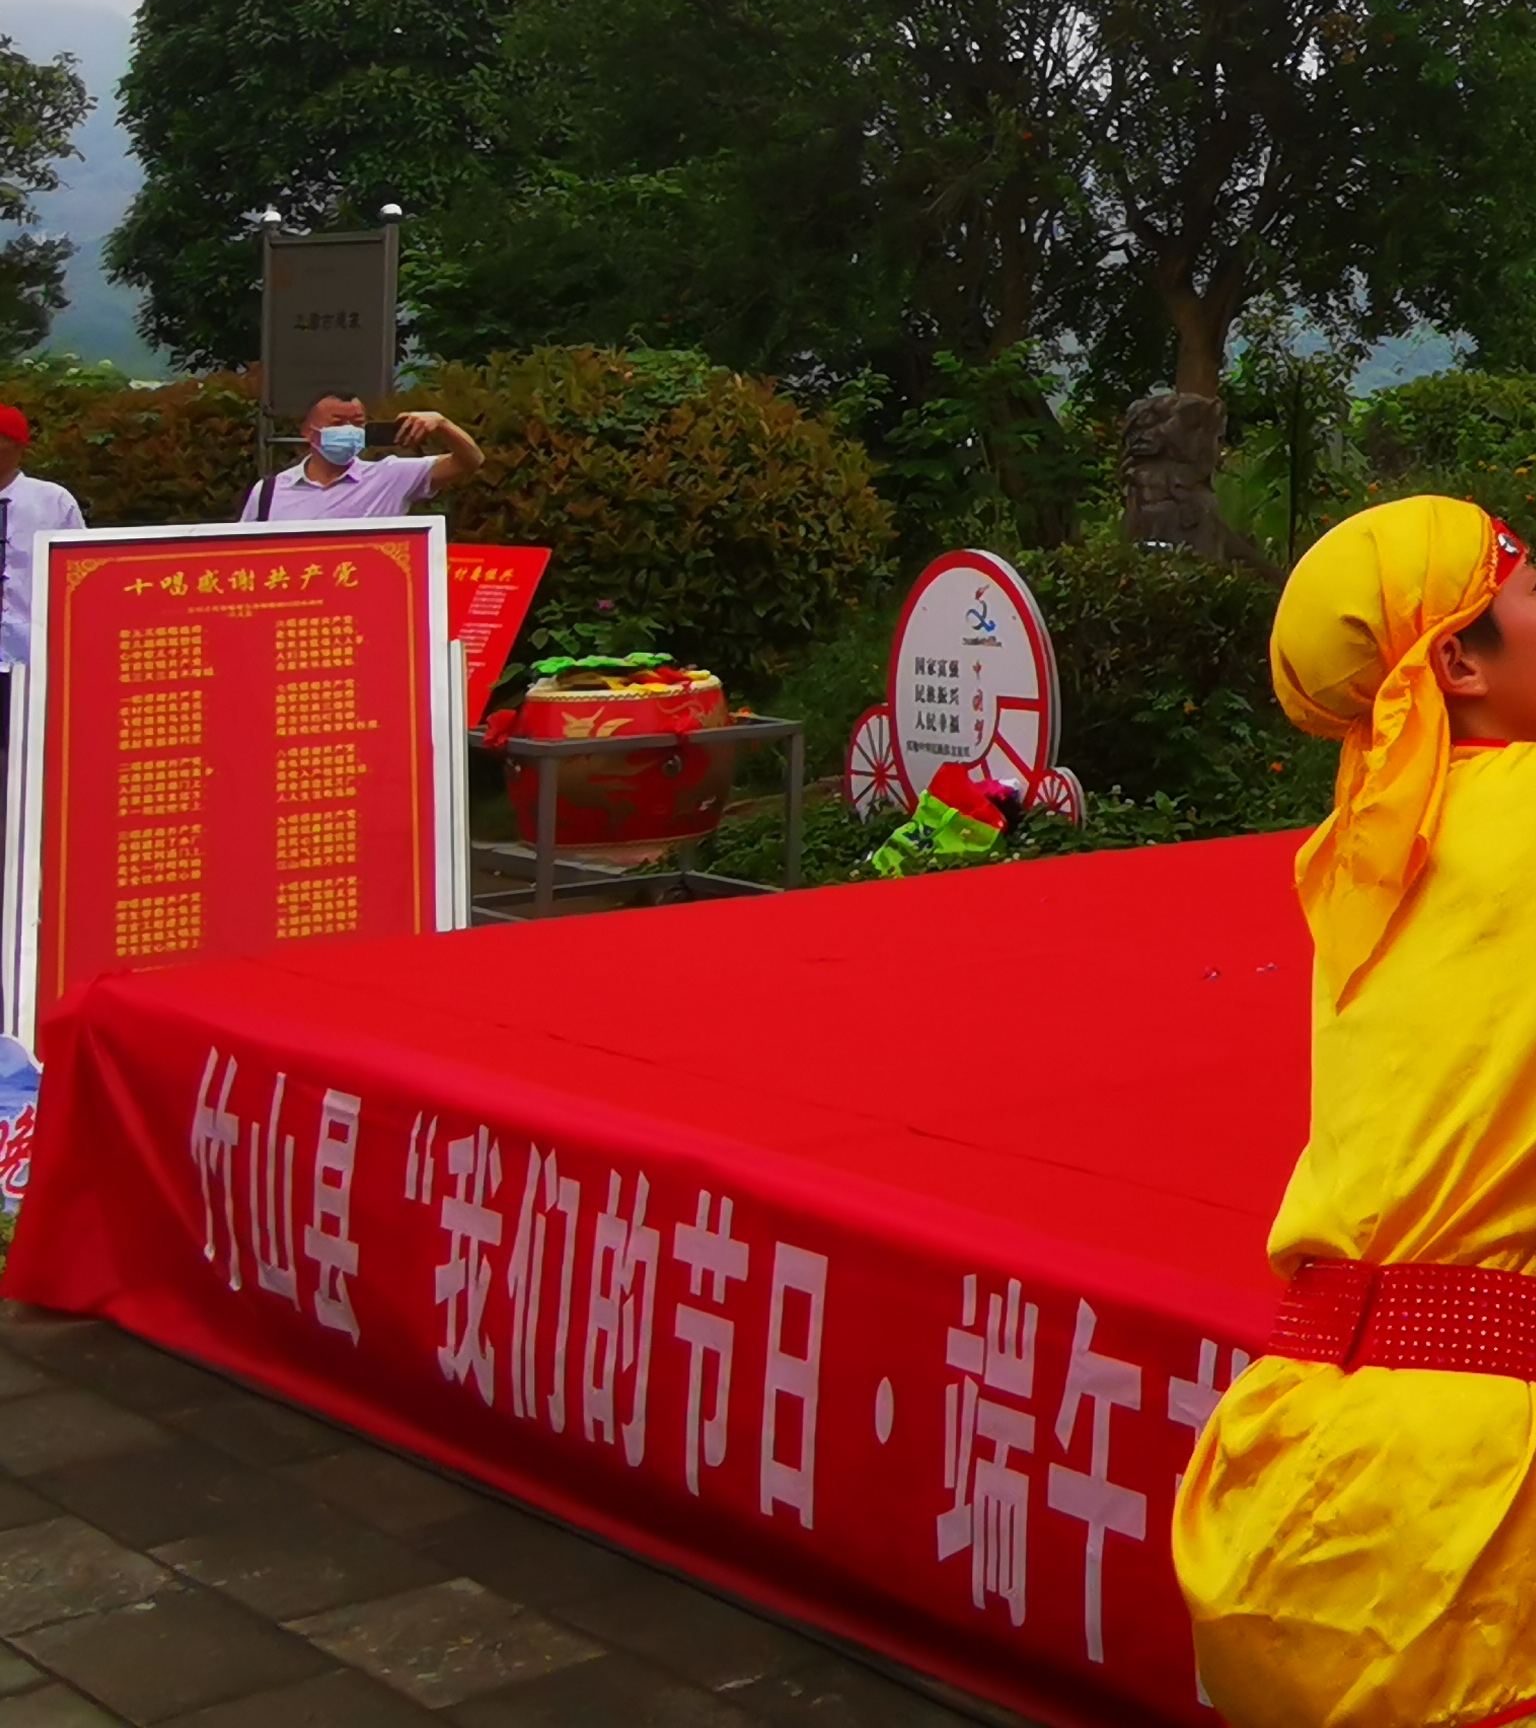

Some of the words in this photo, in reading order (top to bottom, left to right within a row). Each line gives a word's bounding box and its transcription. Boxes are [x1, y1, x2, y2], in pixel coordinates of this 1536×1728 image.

[123, 561, 360, 597] 十唱感谢共产党
